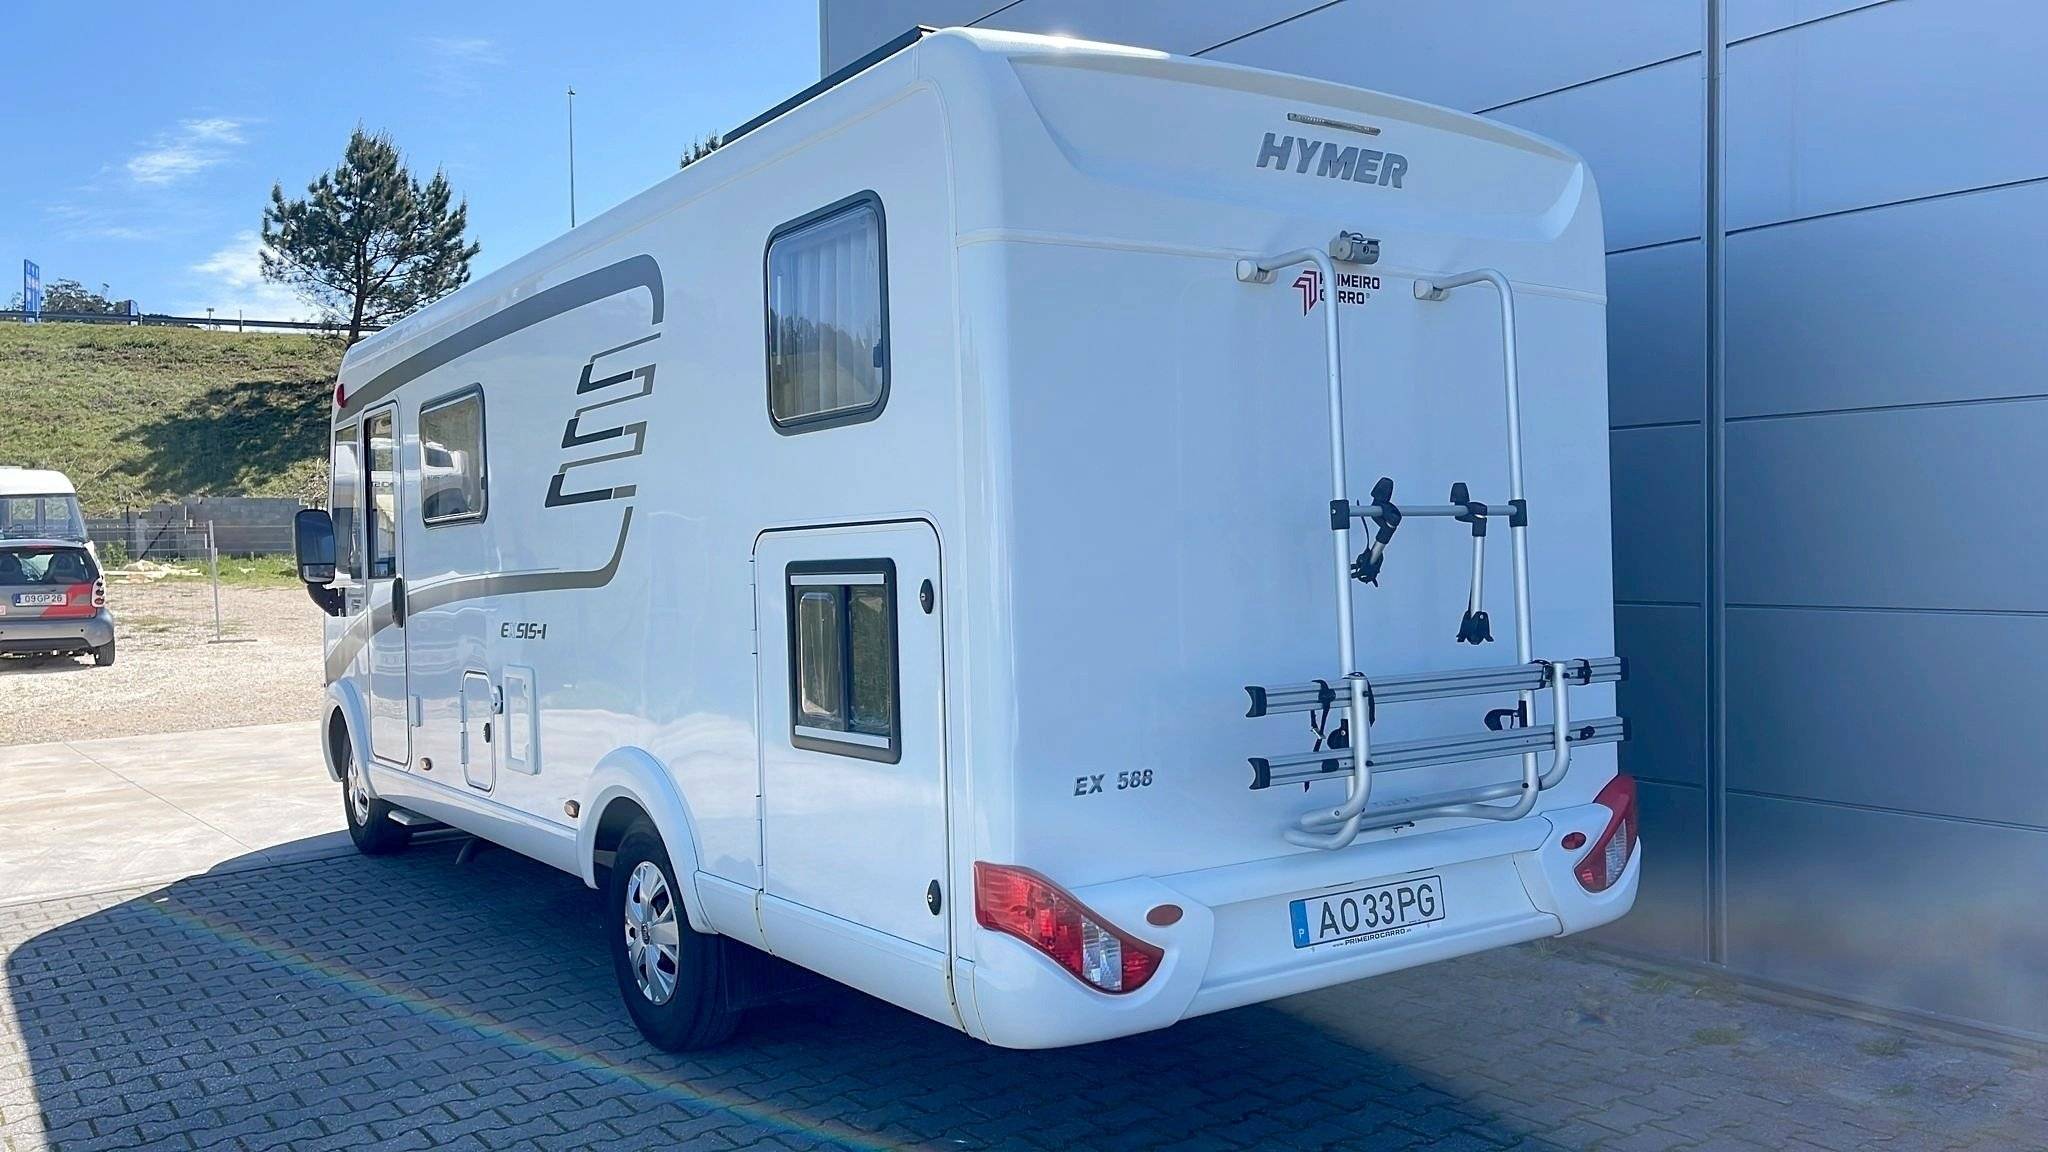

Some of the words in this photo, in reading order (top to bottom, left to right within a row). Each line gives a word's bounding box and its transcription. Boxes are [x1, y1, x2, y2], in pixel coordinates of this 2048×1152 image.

[1256, 132, 1409, 189] HYMER
[1320, 271, 1381, 290] IMEIRO
[1074, 773, 1105, 796] EX
[1117, 768, 1153, 790] 588
